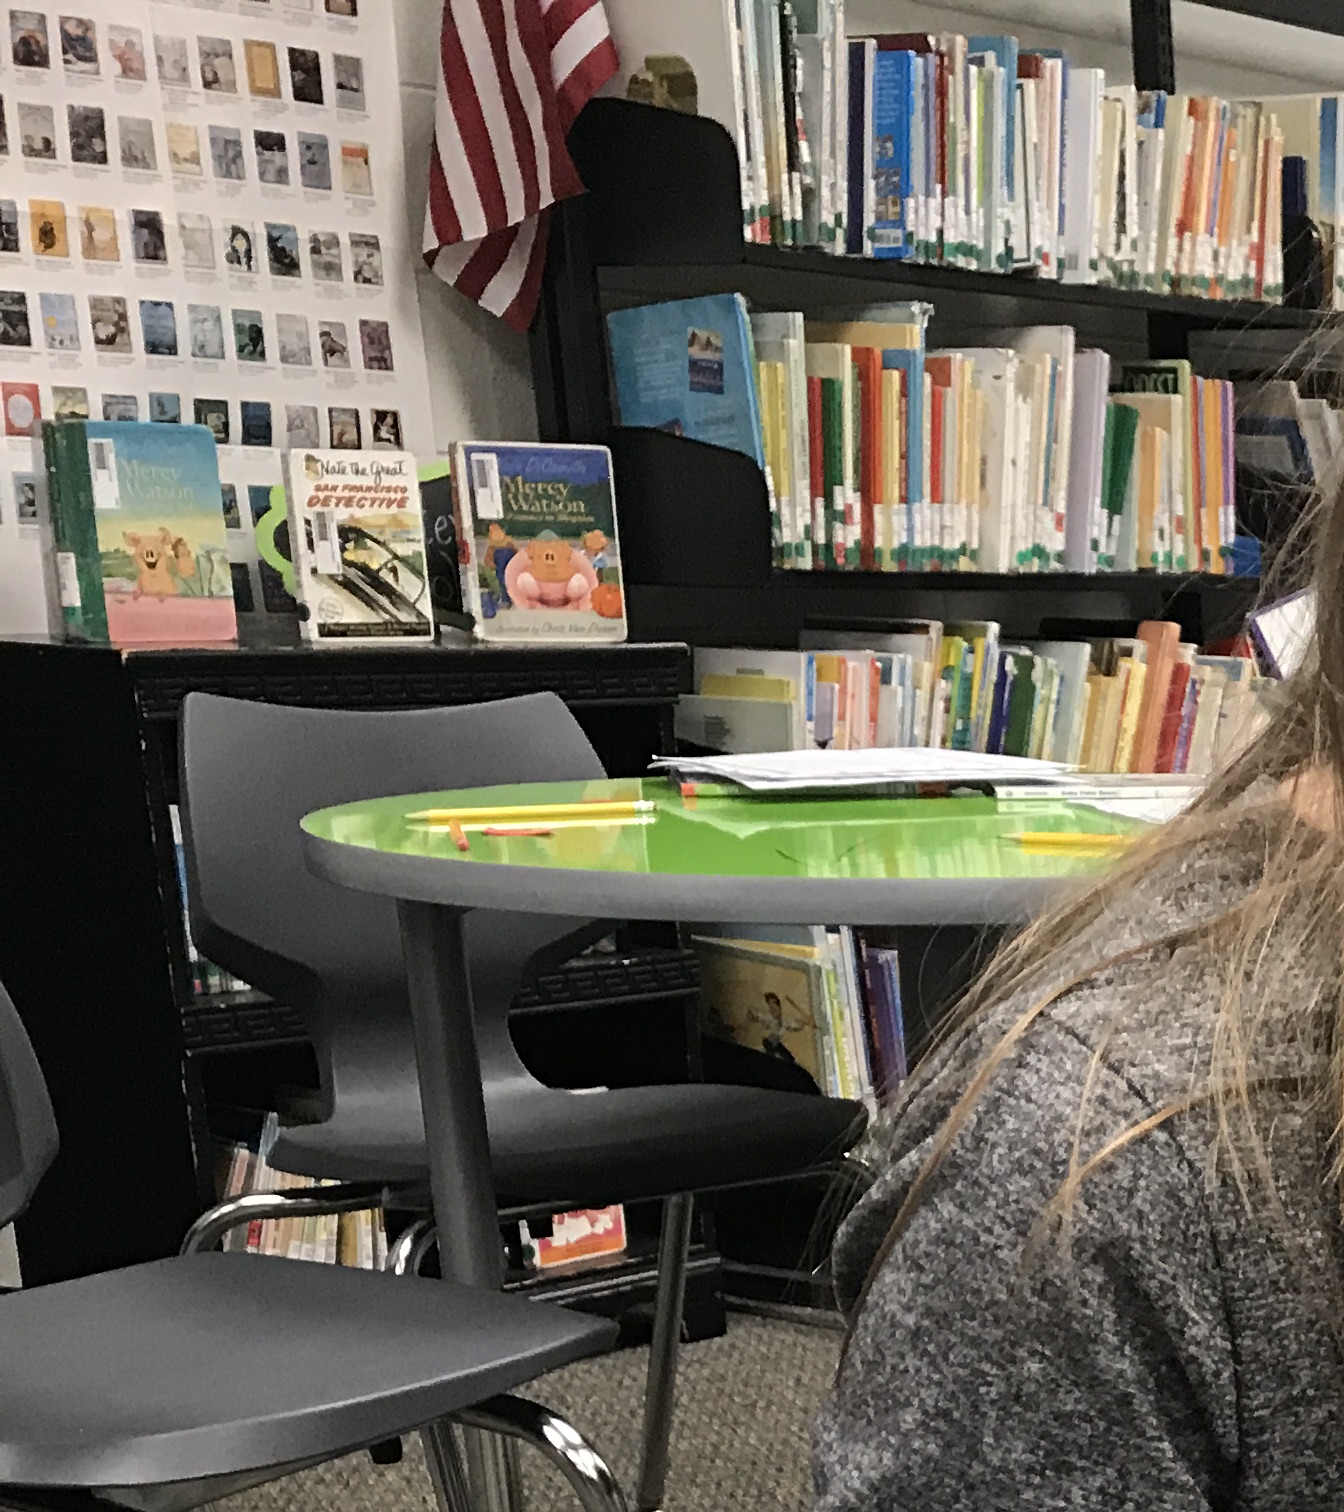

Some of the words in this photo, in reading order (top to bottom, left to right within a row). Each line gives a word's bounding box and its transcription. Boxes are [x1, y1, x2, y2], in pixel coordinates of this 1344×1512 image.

[320, 460, 347, 479] Nate
[313, 483, 339, 493] SAN
[341, 483, 408, 494] FRANCISCO
[500, 475, 571, 499] Mercy
[306, 495, 410, 509] DETECTIVE
[507, 493, 585, 513] Watson
